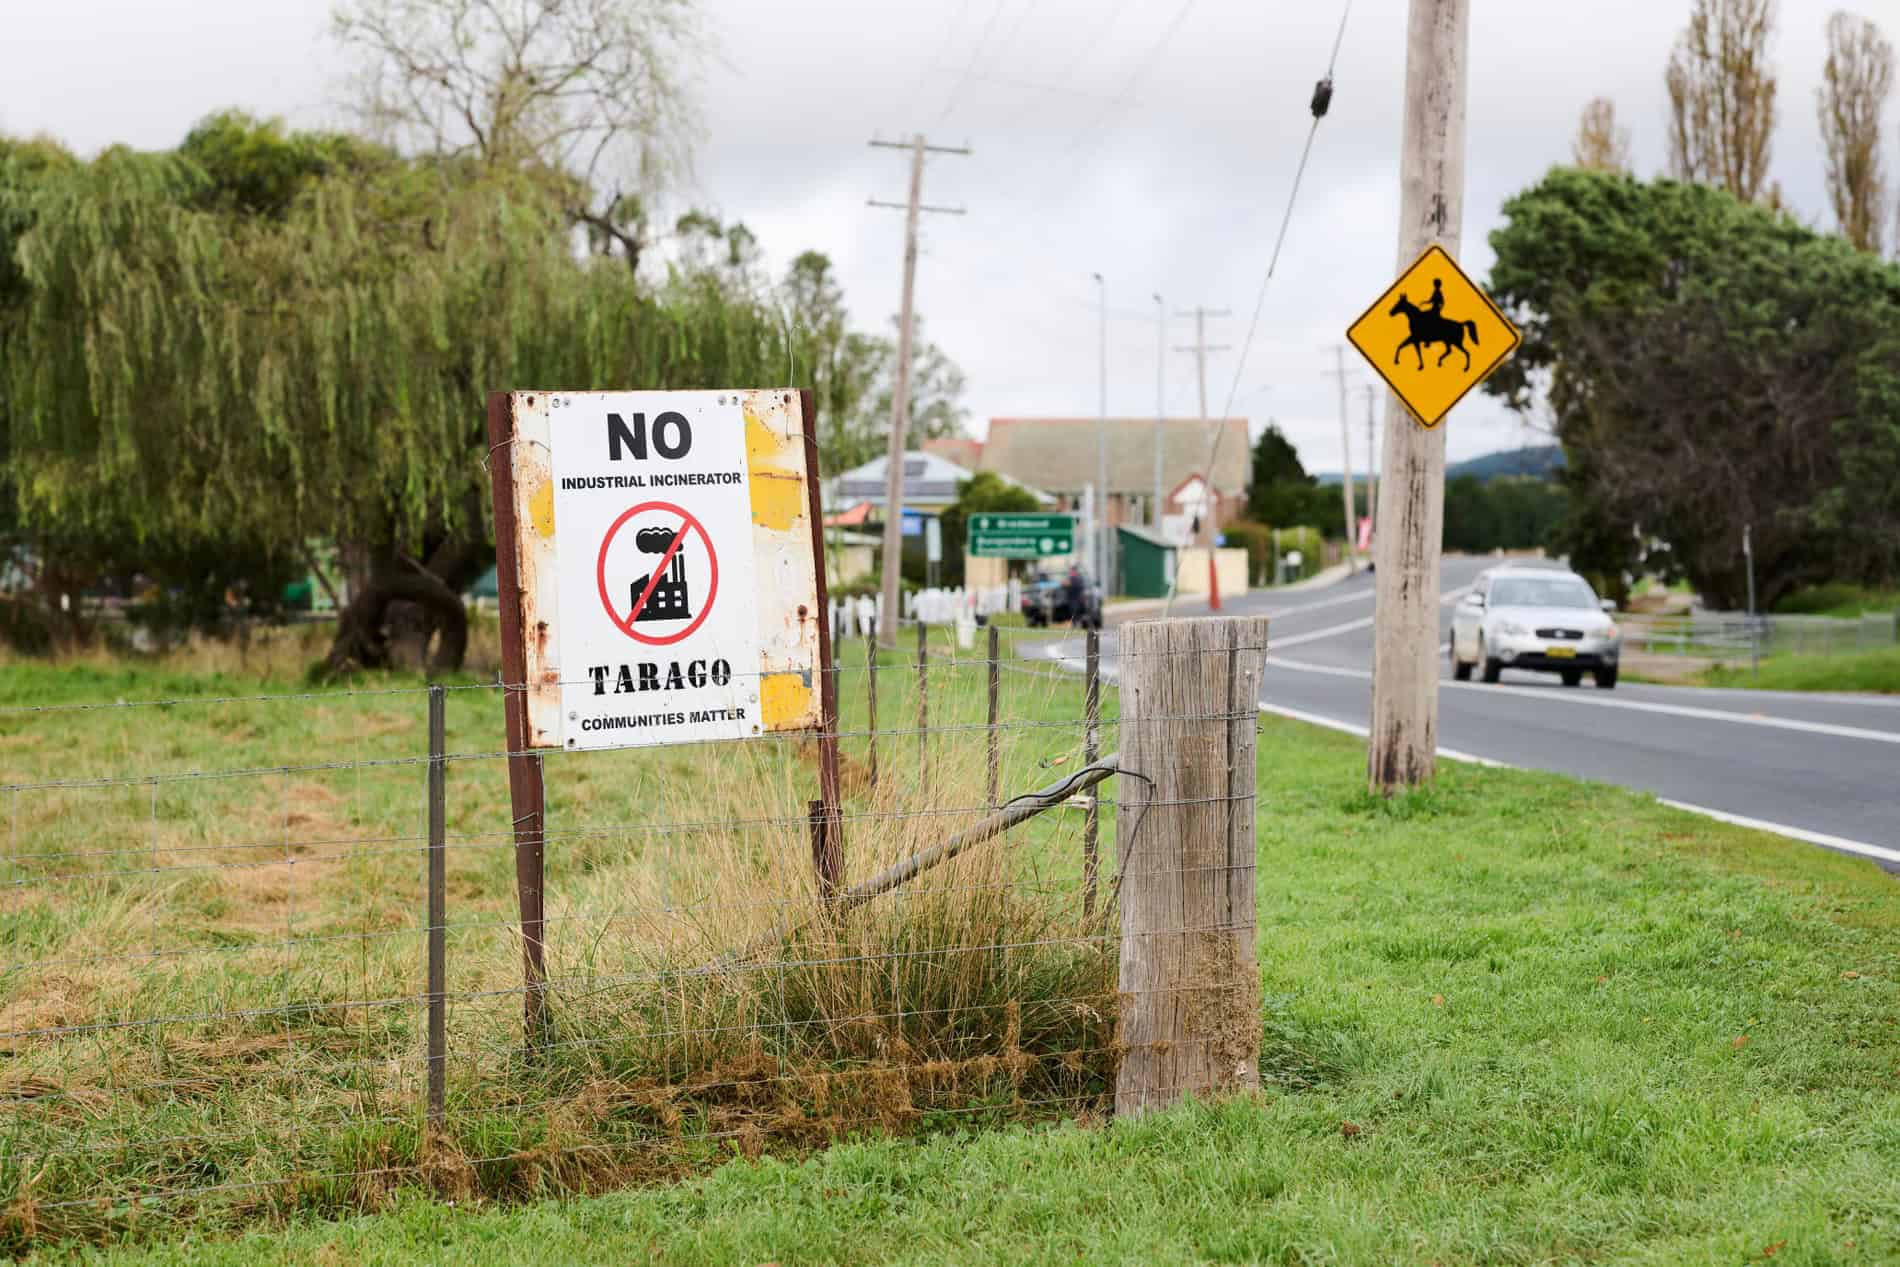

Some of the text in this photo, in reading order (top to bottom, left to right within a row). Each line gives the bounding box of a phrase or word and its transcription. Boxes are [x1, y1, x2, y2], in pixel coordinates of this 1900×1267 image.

[607, 411, 692, 461] NO
[561, 472, 742, 490] INDUSTRIAL INCINERATOR
[588, 658, 732, 696] TARAGO
[581, 707, 746, 731] COMMUNITIES MATTER
